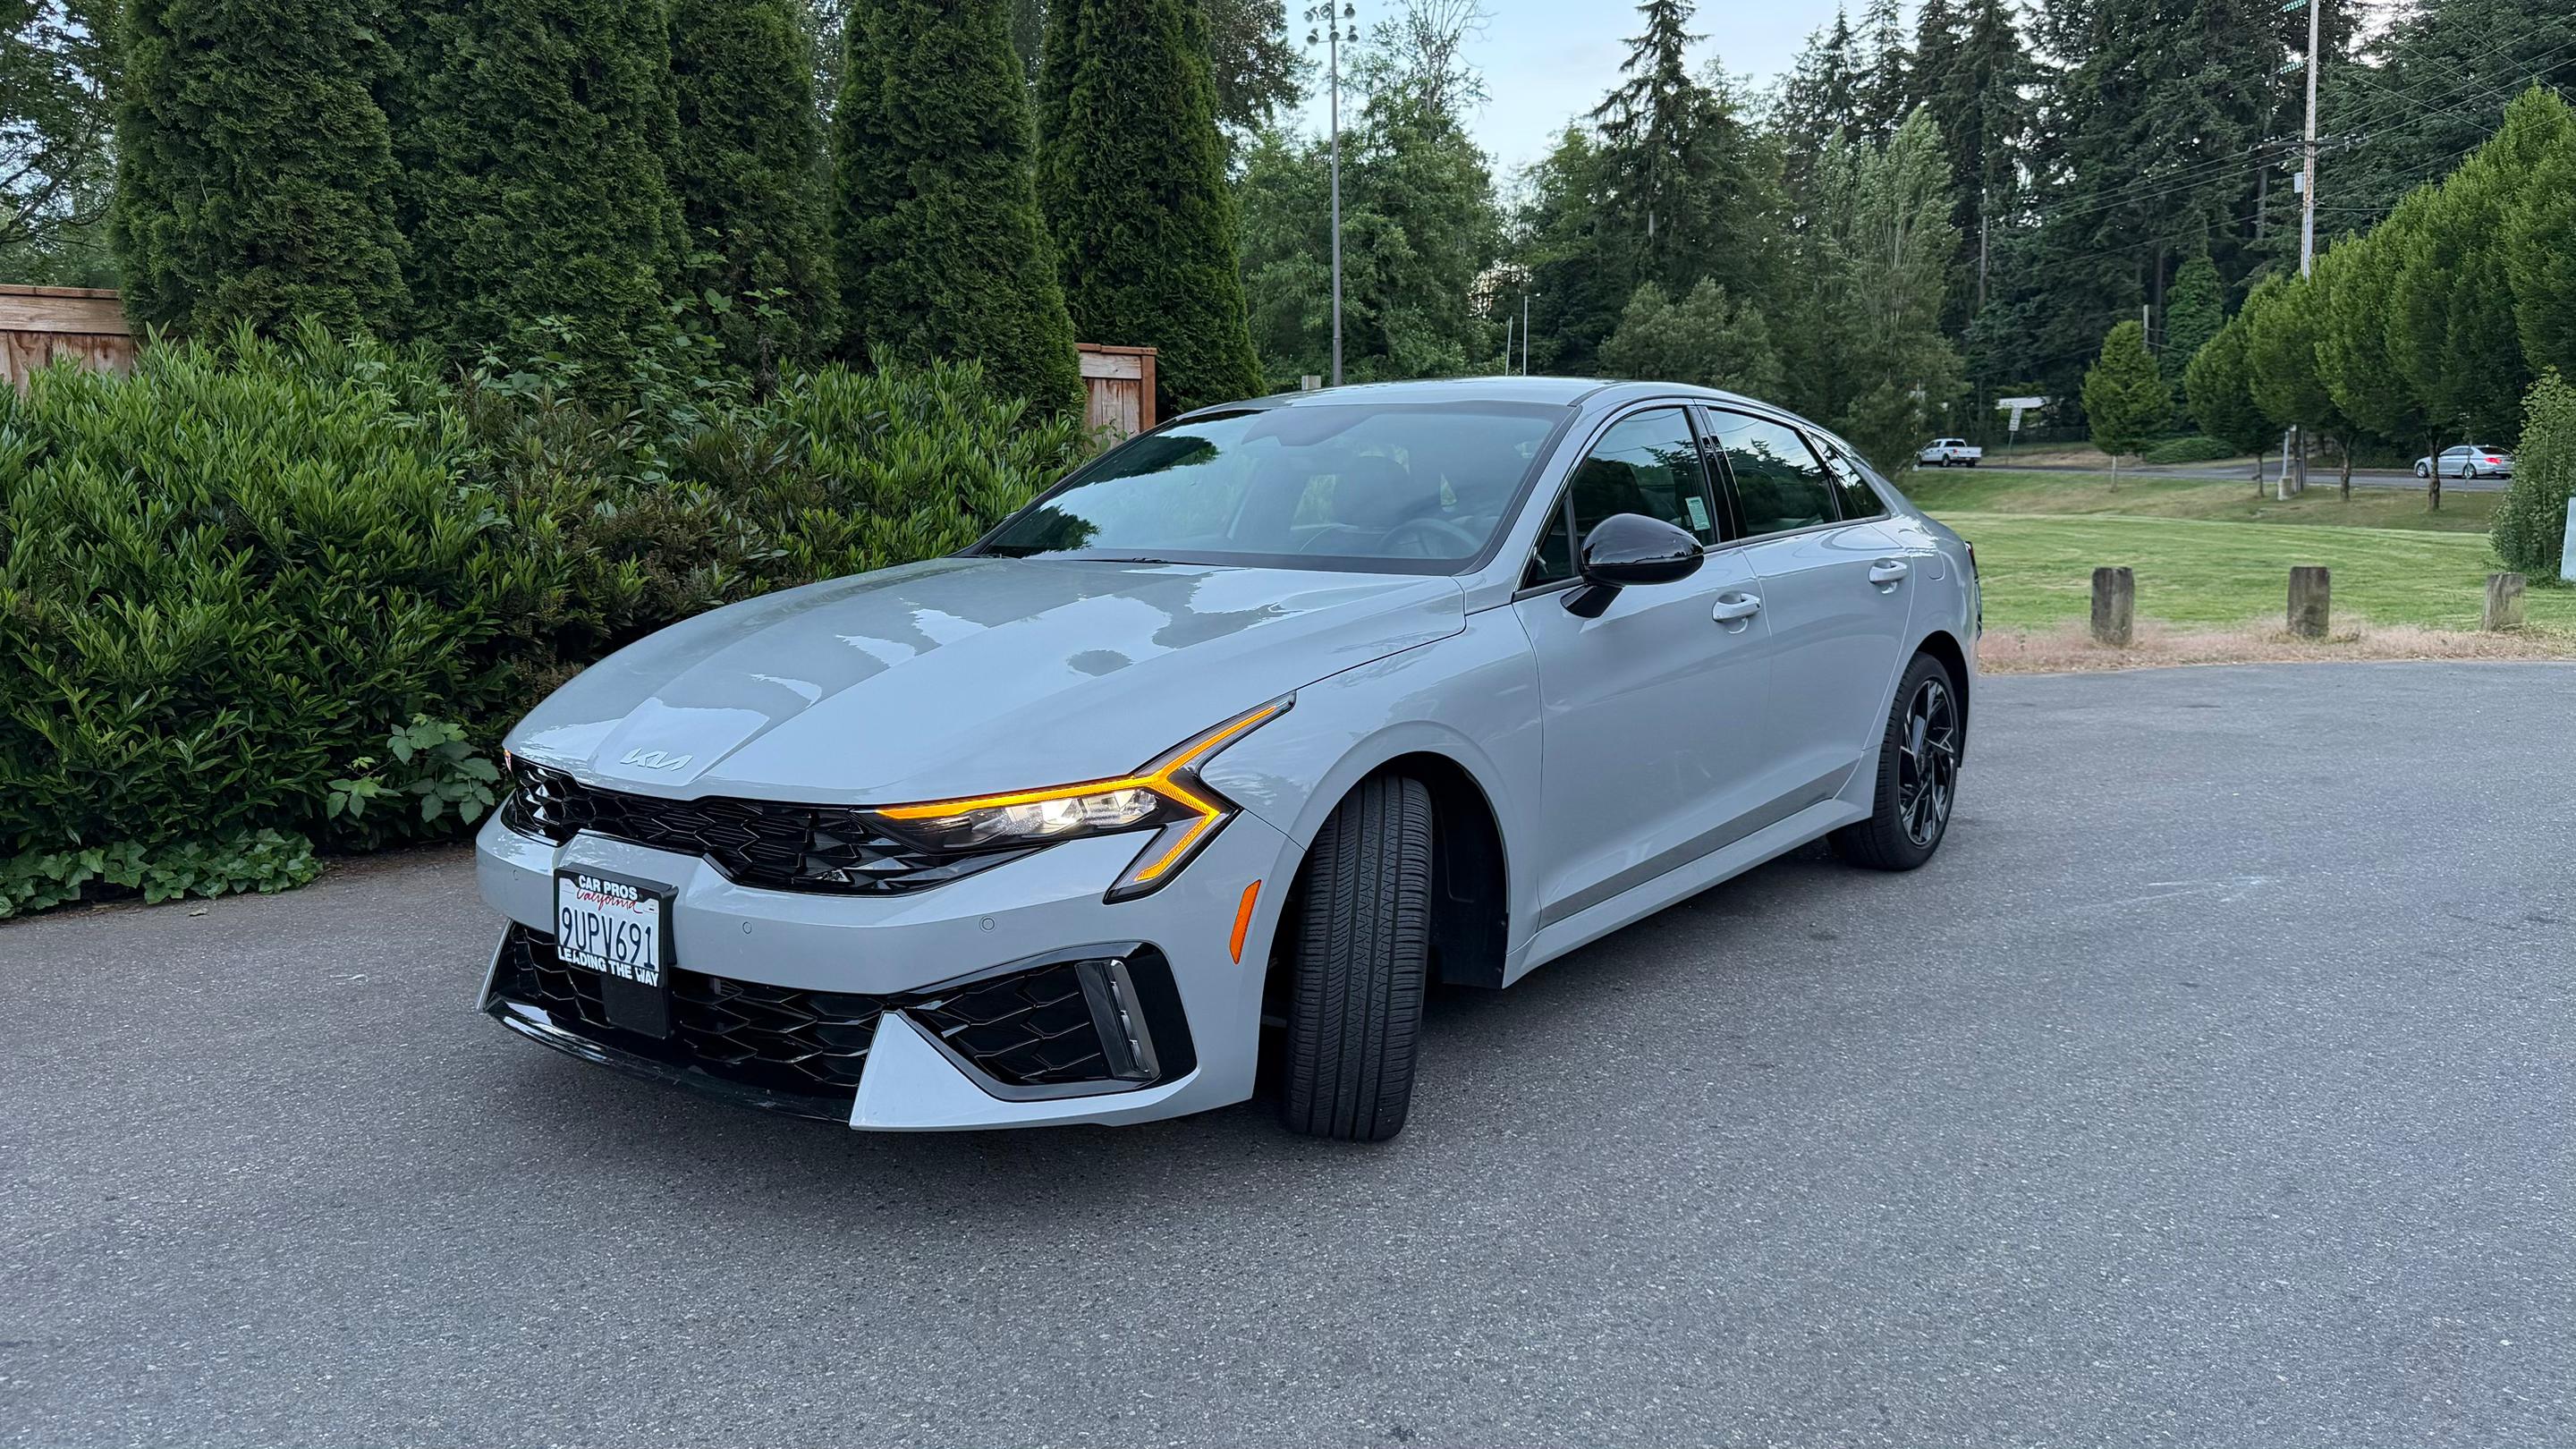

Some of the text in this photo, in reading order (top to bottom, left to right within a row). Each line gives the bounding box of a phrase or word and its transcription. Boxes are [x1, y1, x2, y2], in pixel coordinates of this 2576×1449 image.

[620, 747, 694, 771] KIA
[579, 875, 638, 900] CAR PROS
[562, 906, 656, 970] 9UPV691
[557, 946, 659, 987] LEADING THE WAY
